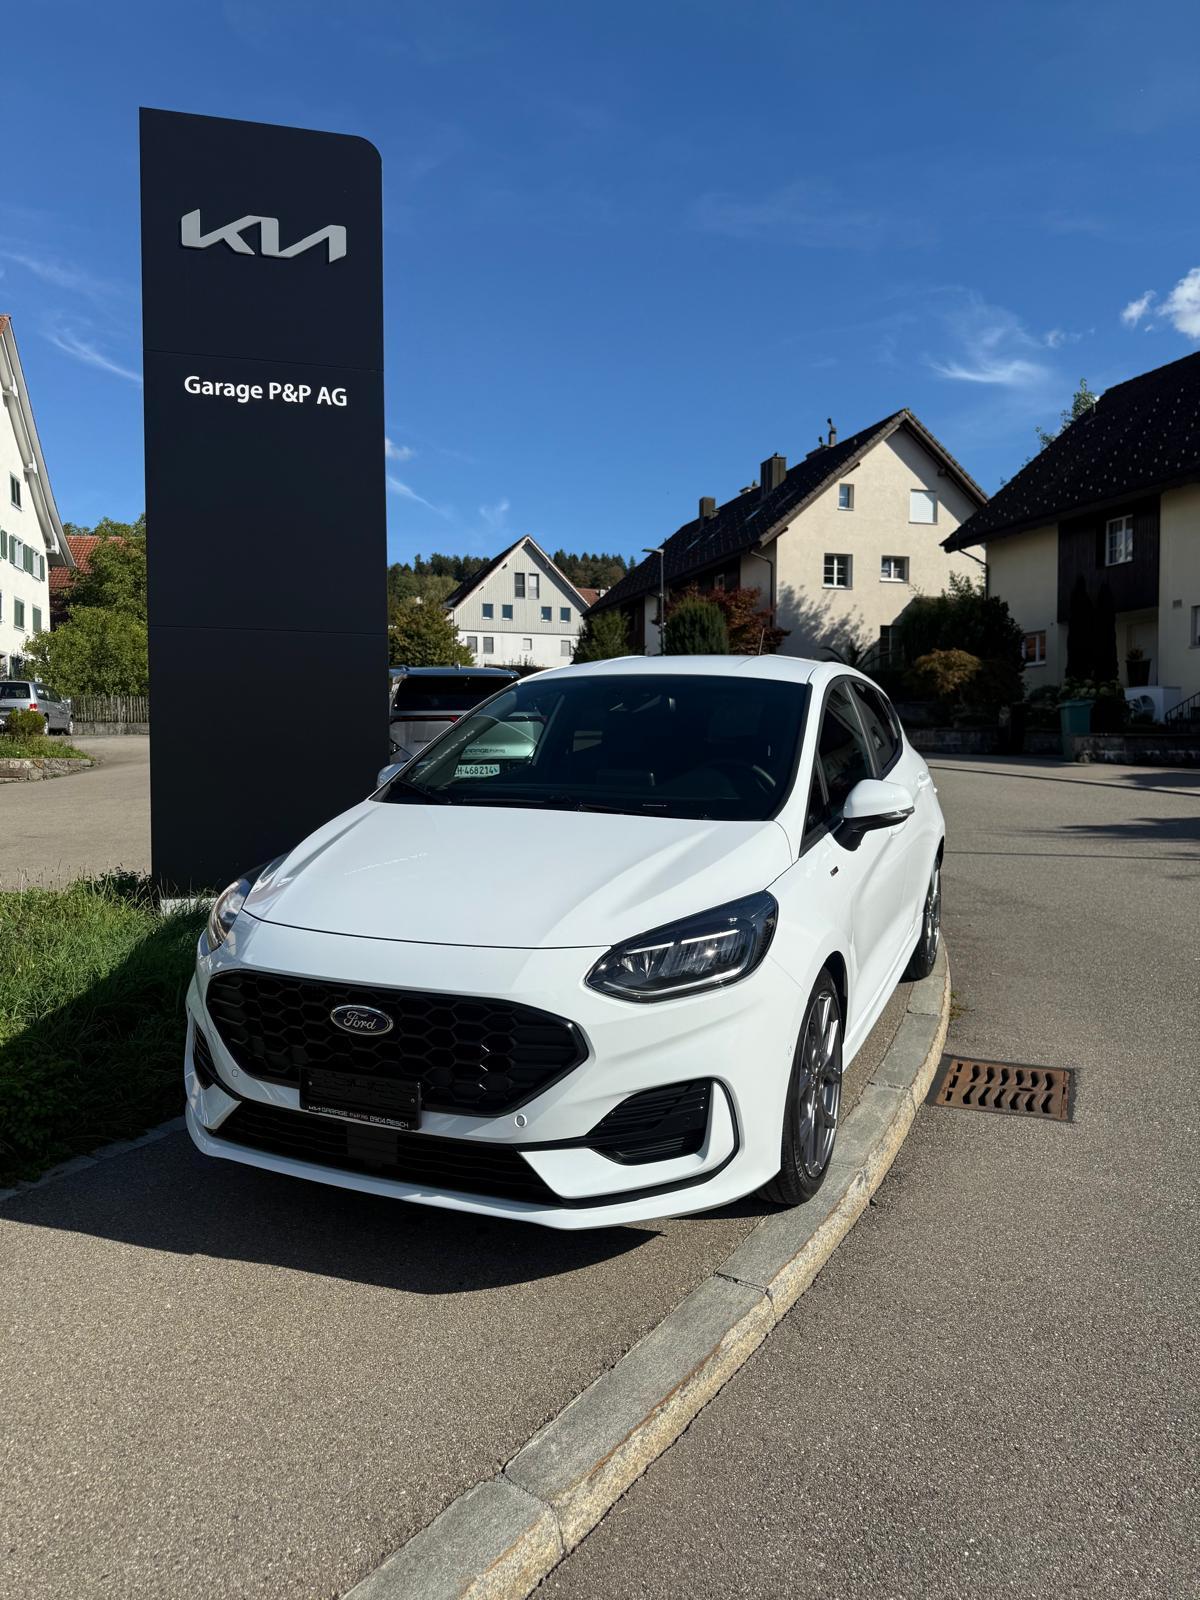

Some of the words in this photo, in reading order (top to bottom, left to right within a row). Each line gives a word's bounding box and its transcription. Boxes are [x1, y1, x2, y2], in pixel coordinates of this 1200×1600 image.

[181, 208, 346, 263] KIA
[184, 375, 263, 403] Garage
[269, 382, 311, 403] P&P
[316, 386, 347, 406] AG
[343, 1011, 377, 1030] Ford
